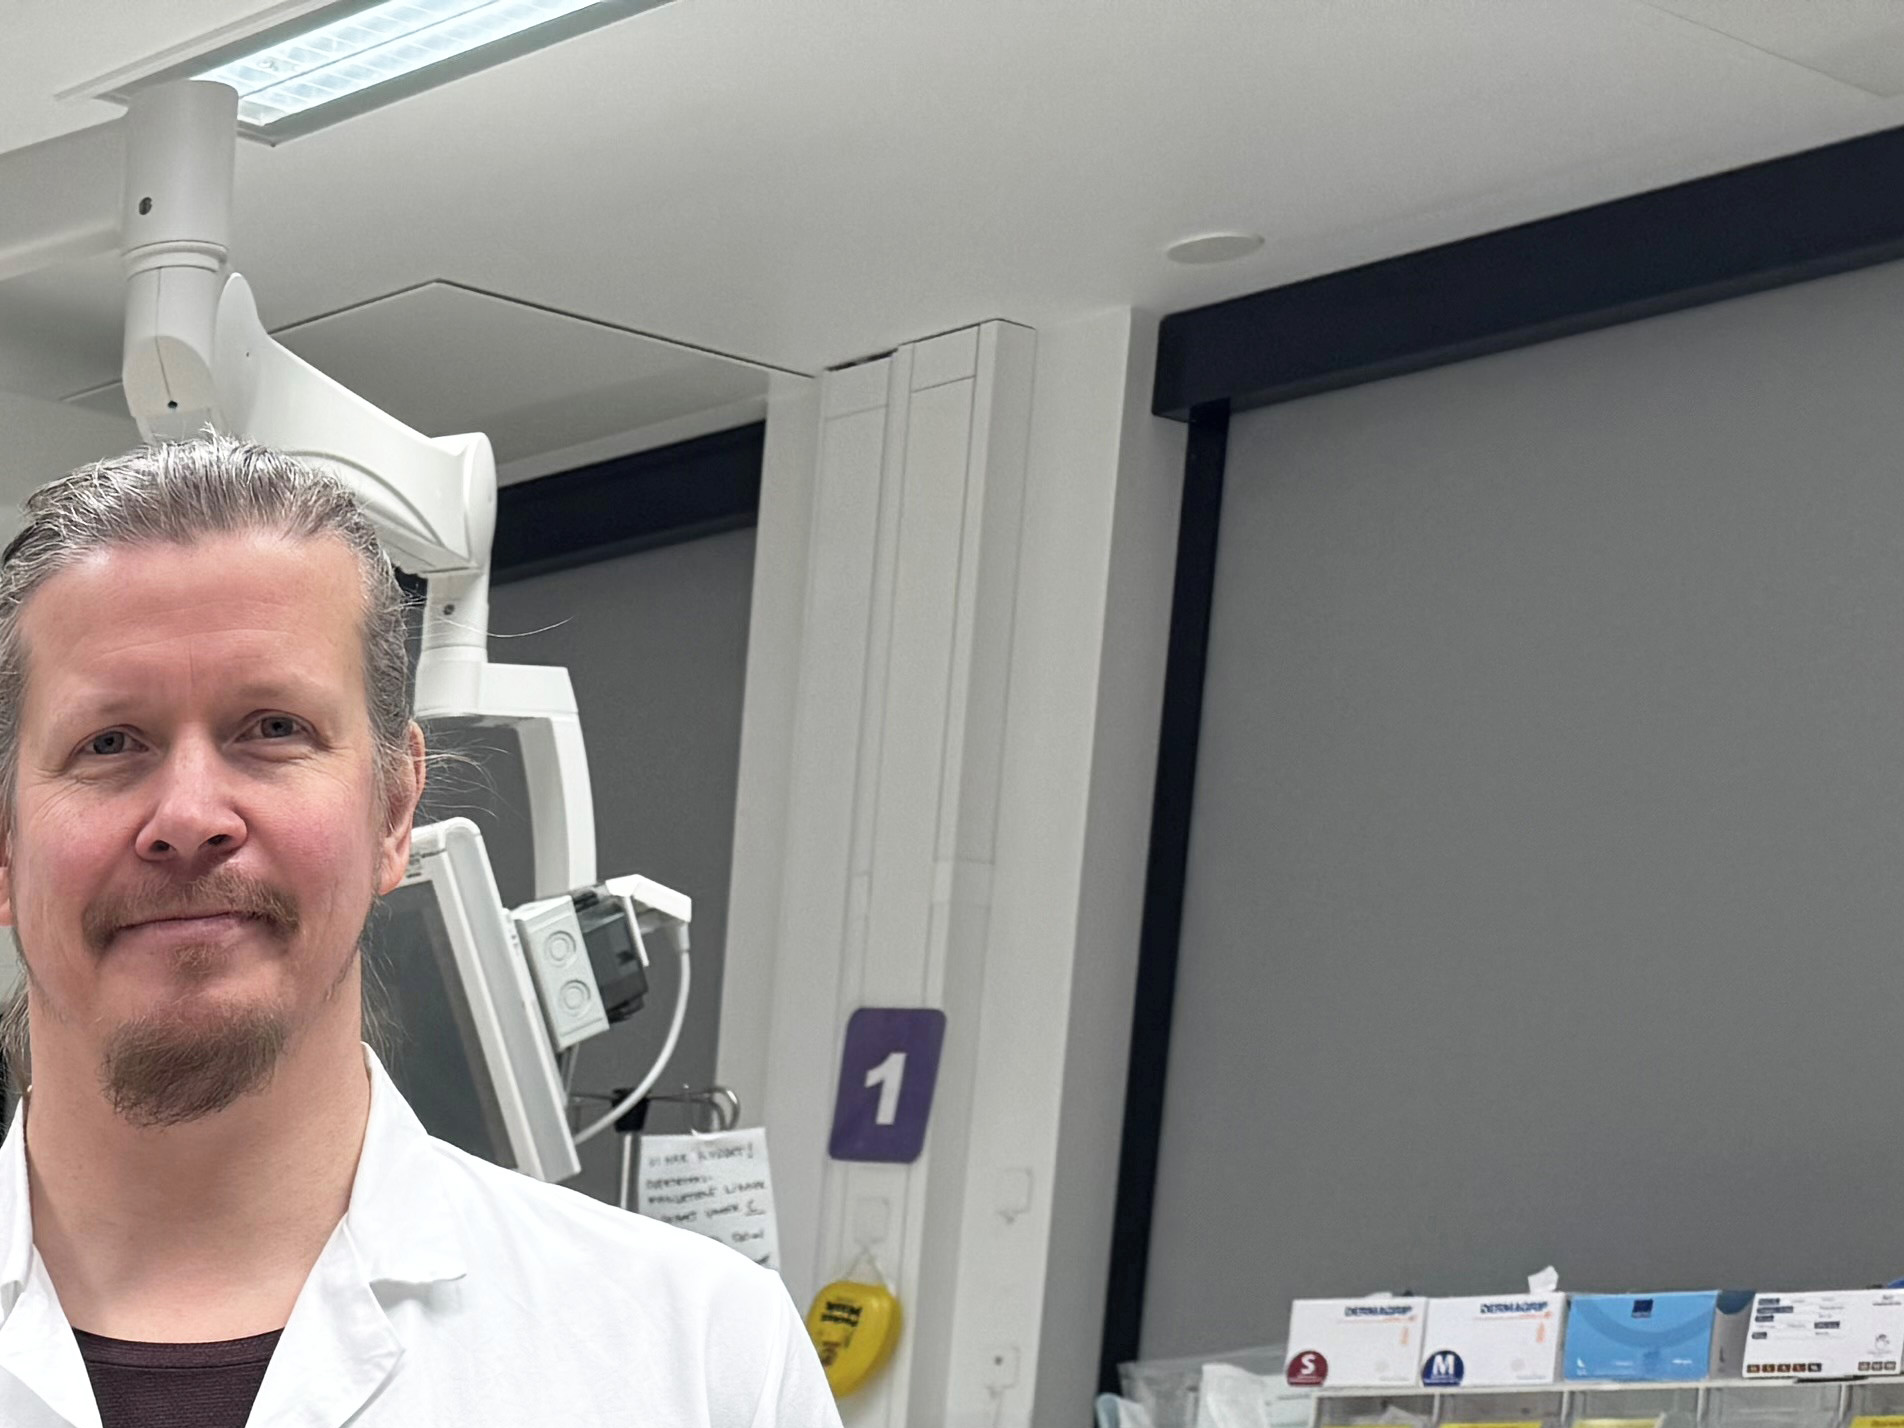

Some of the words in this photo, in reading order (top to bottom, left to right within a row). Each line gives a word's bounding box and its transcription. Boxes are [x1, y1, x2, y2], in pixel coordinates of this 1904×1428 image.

[863, 1051, 908, 1126] 1
[1300, 1354, 1317, 1375] S
[1431, 1354, 1456, 1375] M
